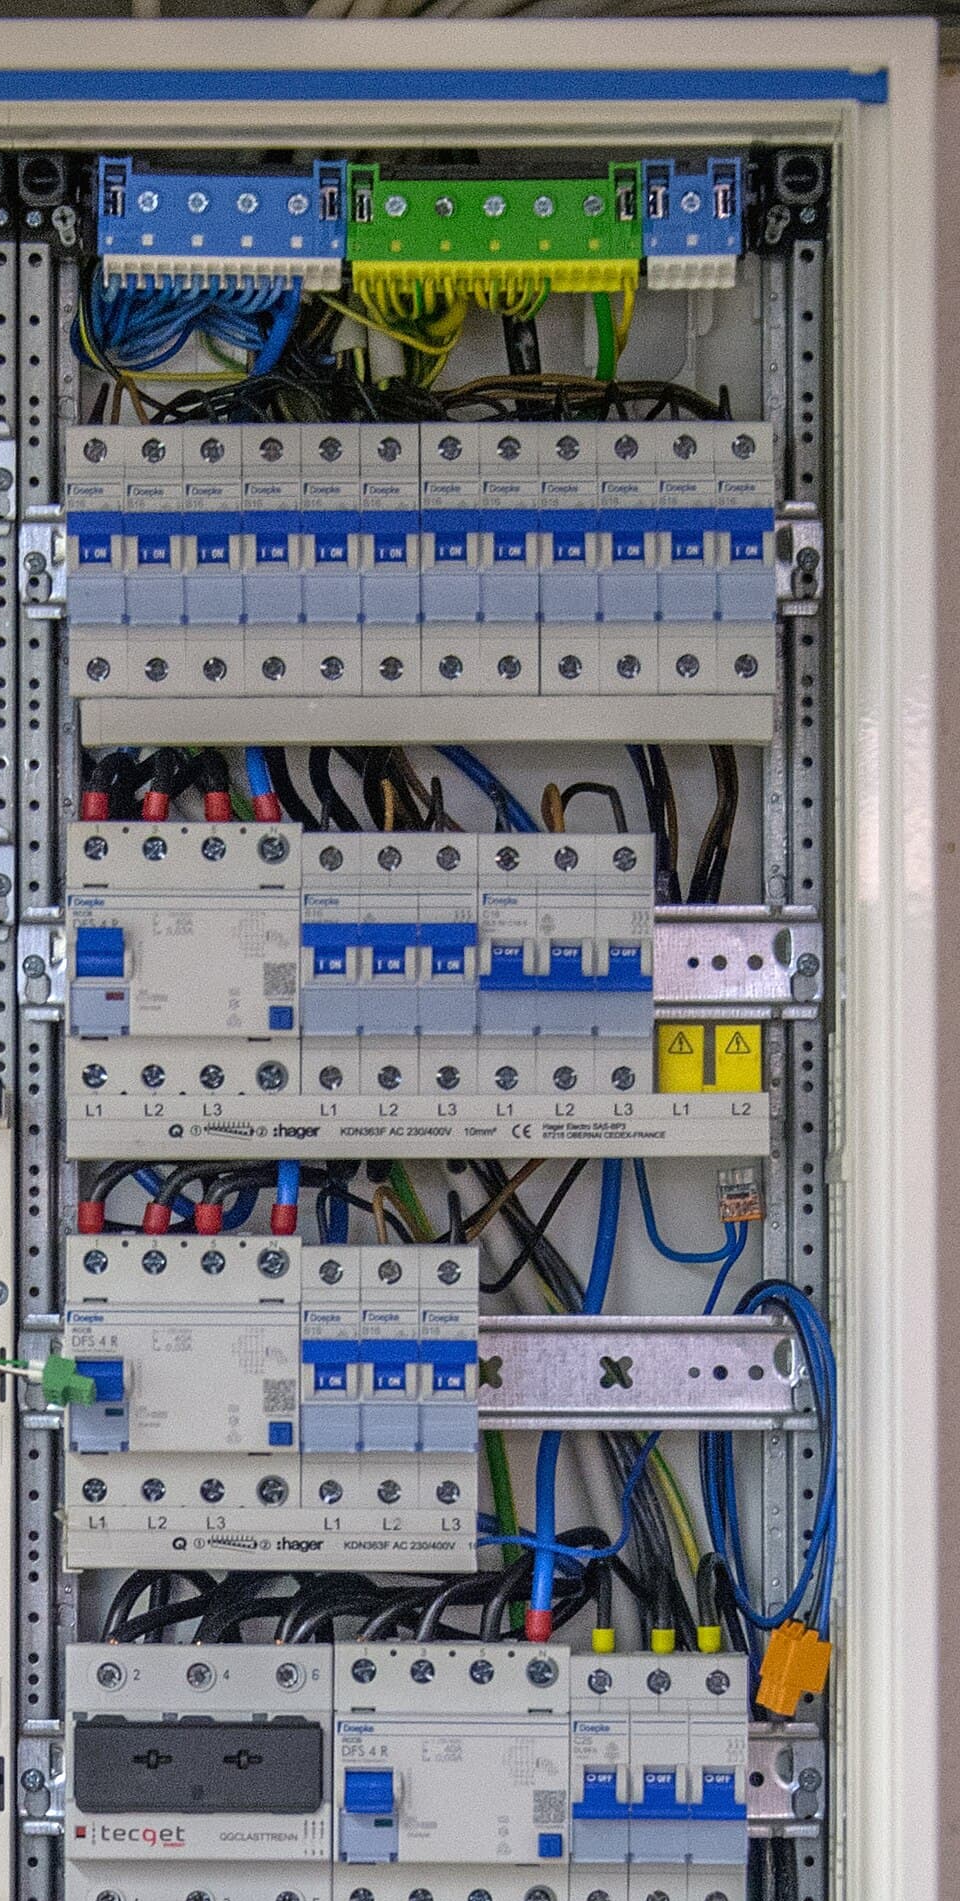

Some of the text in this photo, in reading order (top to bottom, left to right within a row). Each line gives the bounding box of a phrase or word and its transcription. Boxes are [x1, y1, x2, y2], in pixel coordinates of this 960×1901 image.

[86, 1104, 751, 1116] L1 L2 L3 L1 L2 L3 L1 L2 L3 L1 L2
[390, 1128, 404, 1136] AC
[406, 1127, 452, 1136] 230/400V
[72, 1336, 118, 1348] DFS 4 R
[89, 1516, 462, 1530] L1 L2 L3 L1 L2 L3
[392, 1540, 408, 1550] AC
[410, 1540, 456, 1550] 230/400V
[133, 1670, 140, 1680] 2
[223, 1670, 230, 1680] 4
[312, 1670, 320, 1680] 6
[342, 1746, 388, 1758] DFS 4 R
[101, 1826, 186, 1847] tecget
